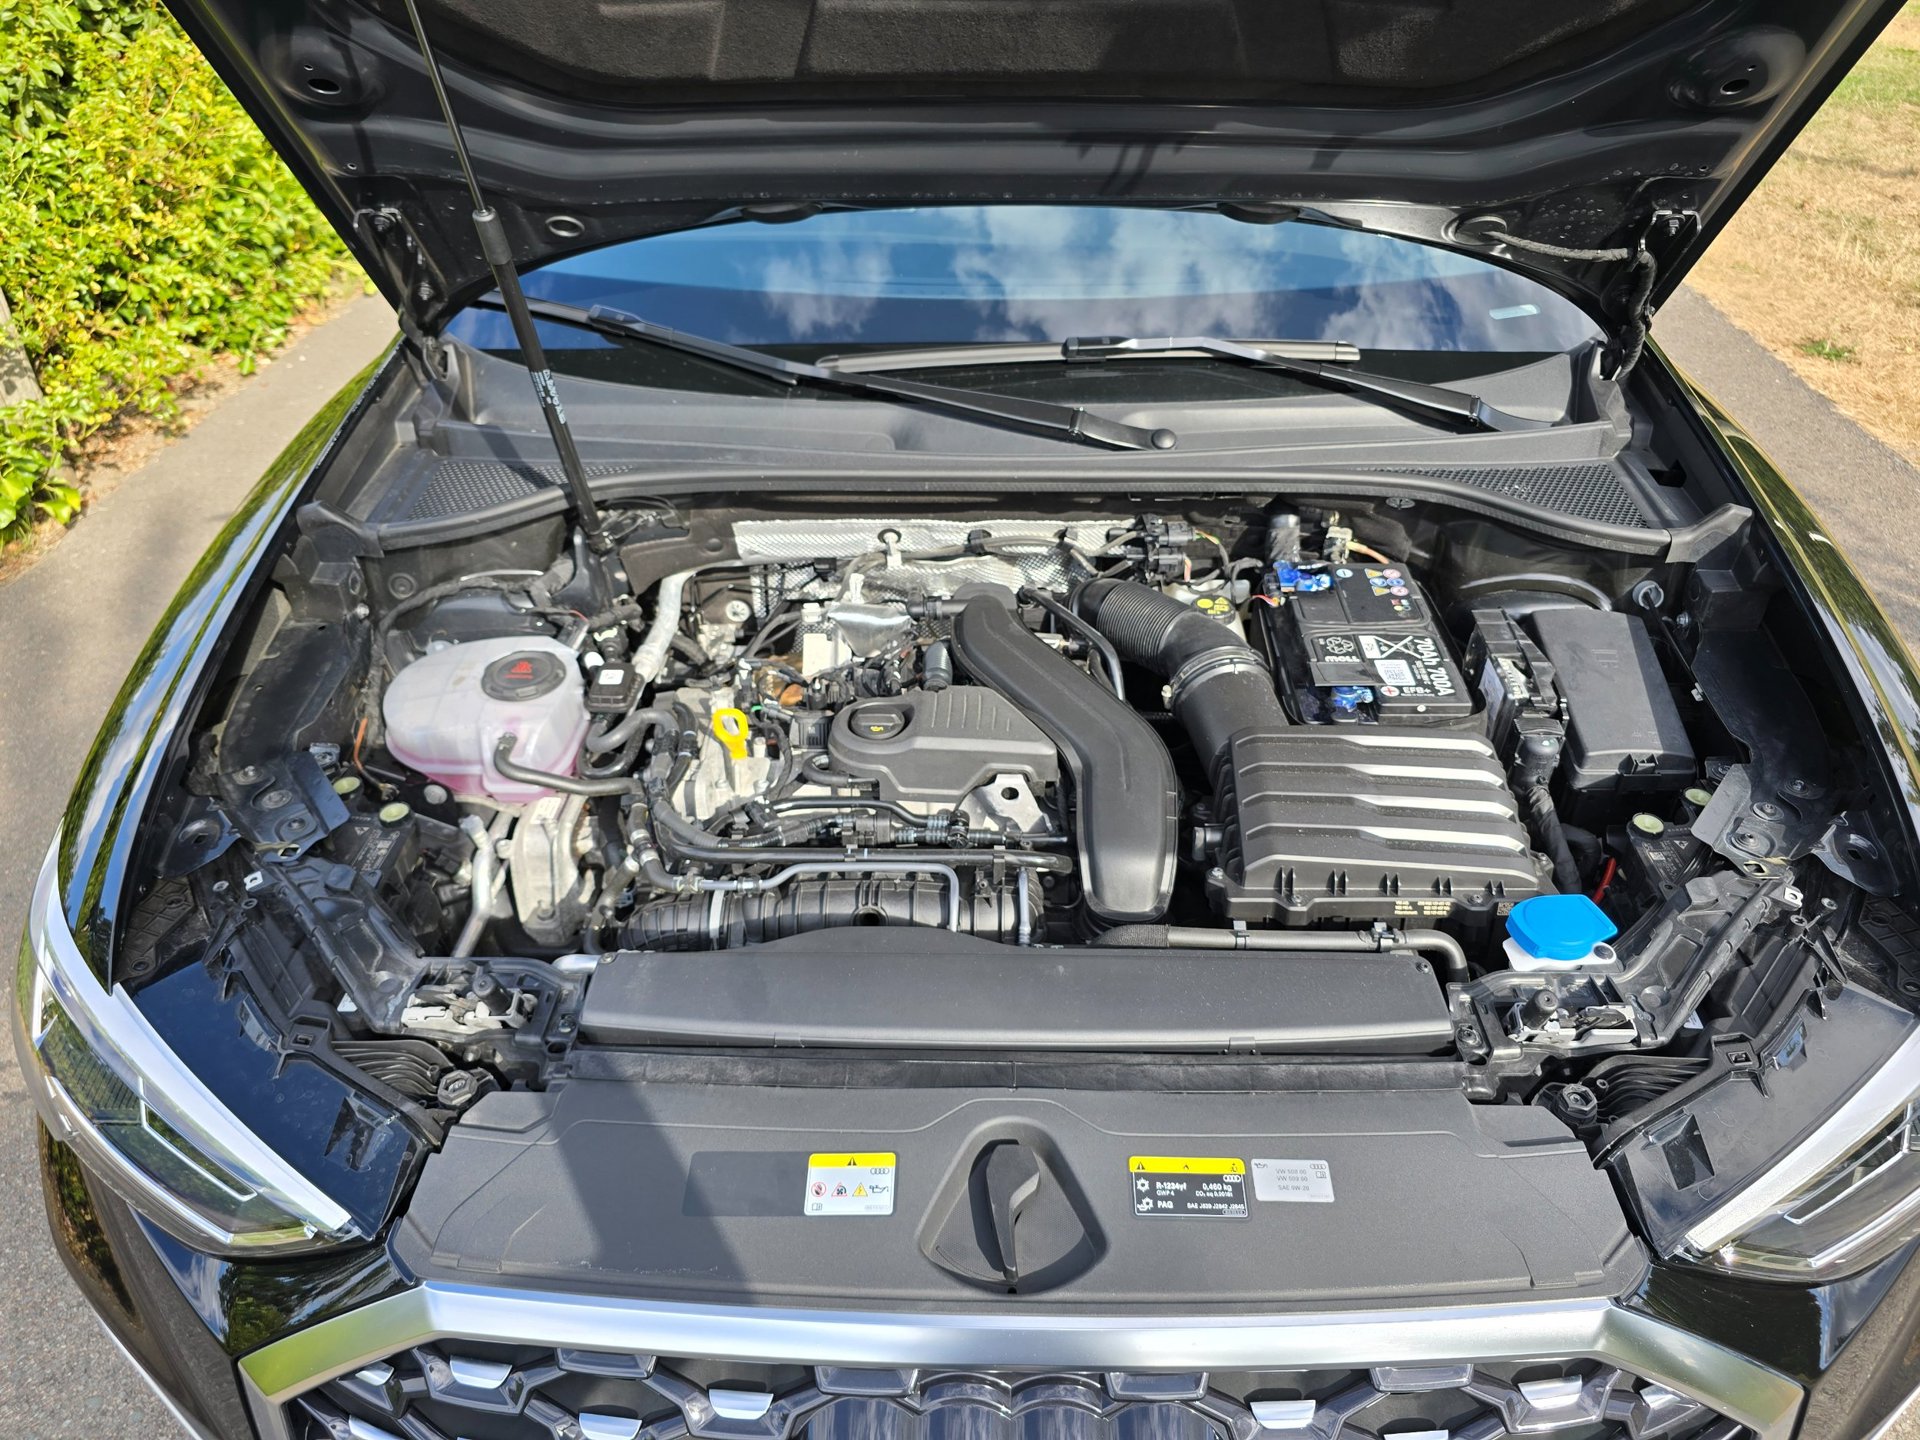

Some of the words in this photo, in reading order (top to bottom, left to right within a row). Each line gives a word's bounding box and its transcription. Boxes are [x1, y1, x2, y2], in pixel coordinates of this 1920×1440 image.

[1414, 637, 1437, 666] 70Ah
[1427, 667, 1455, 696] 700A
[1156, 1181, 1187, 1191] R-1234yf
[1223, 1183, 1232, 1191] kg
